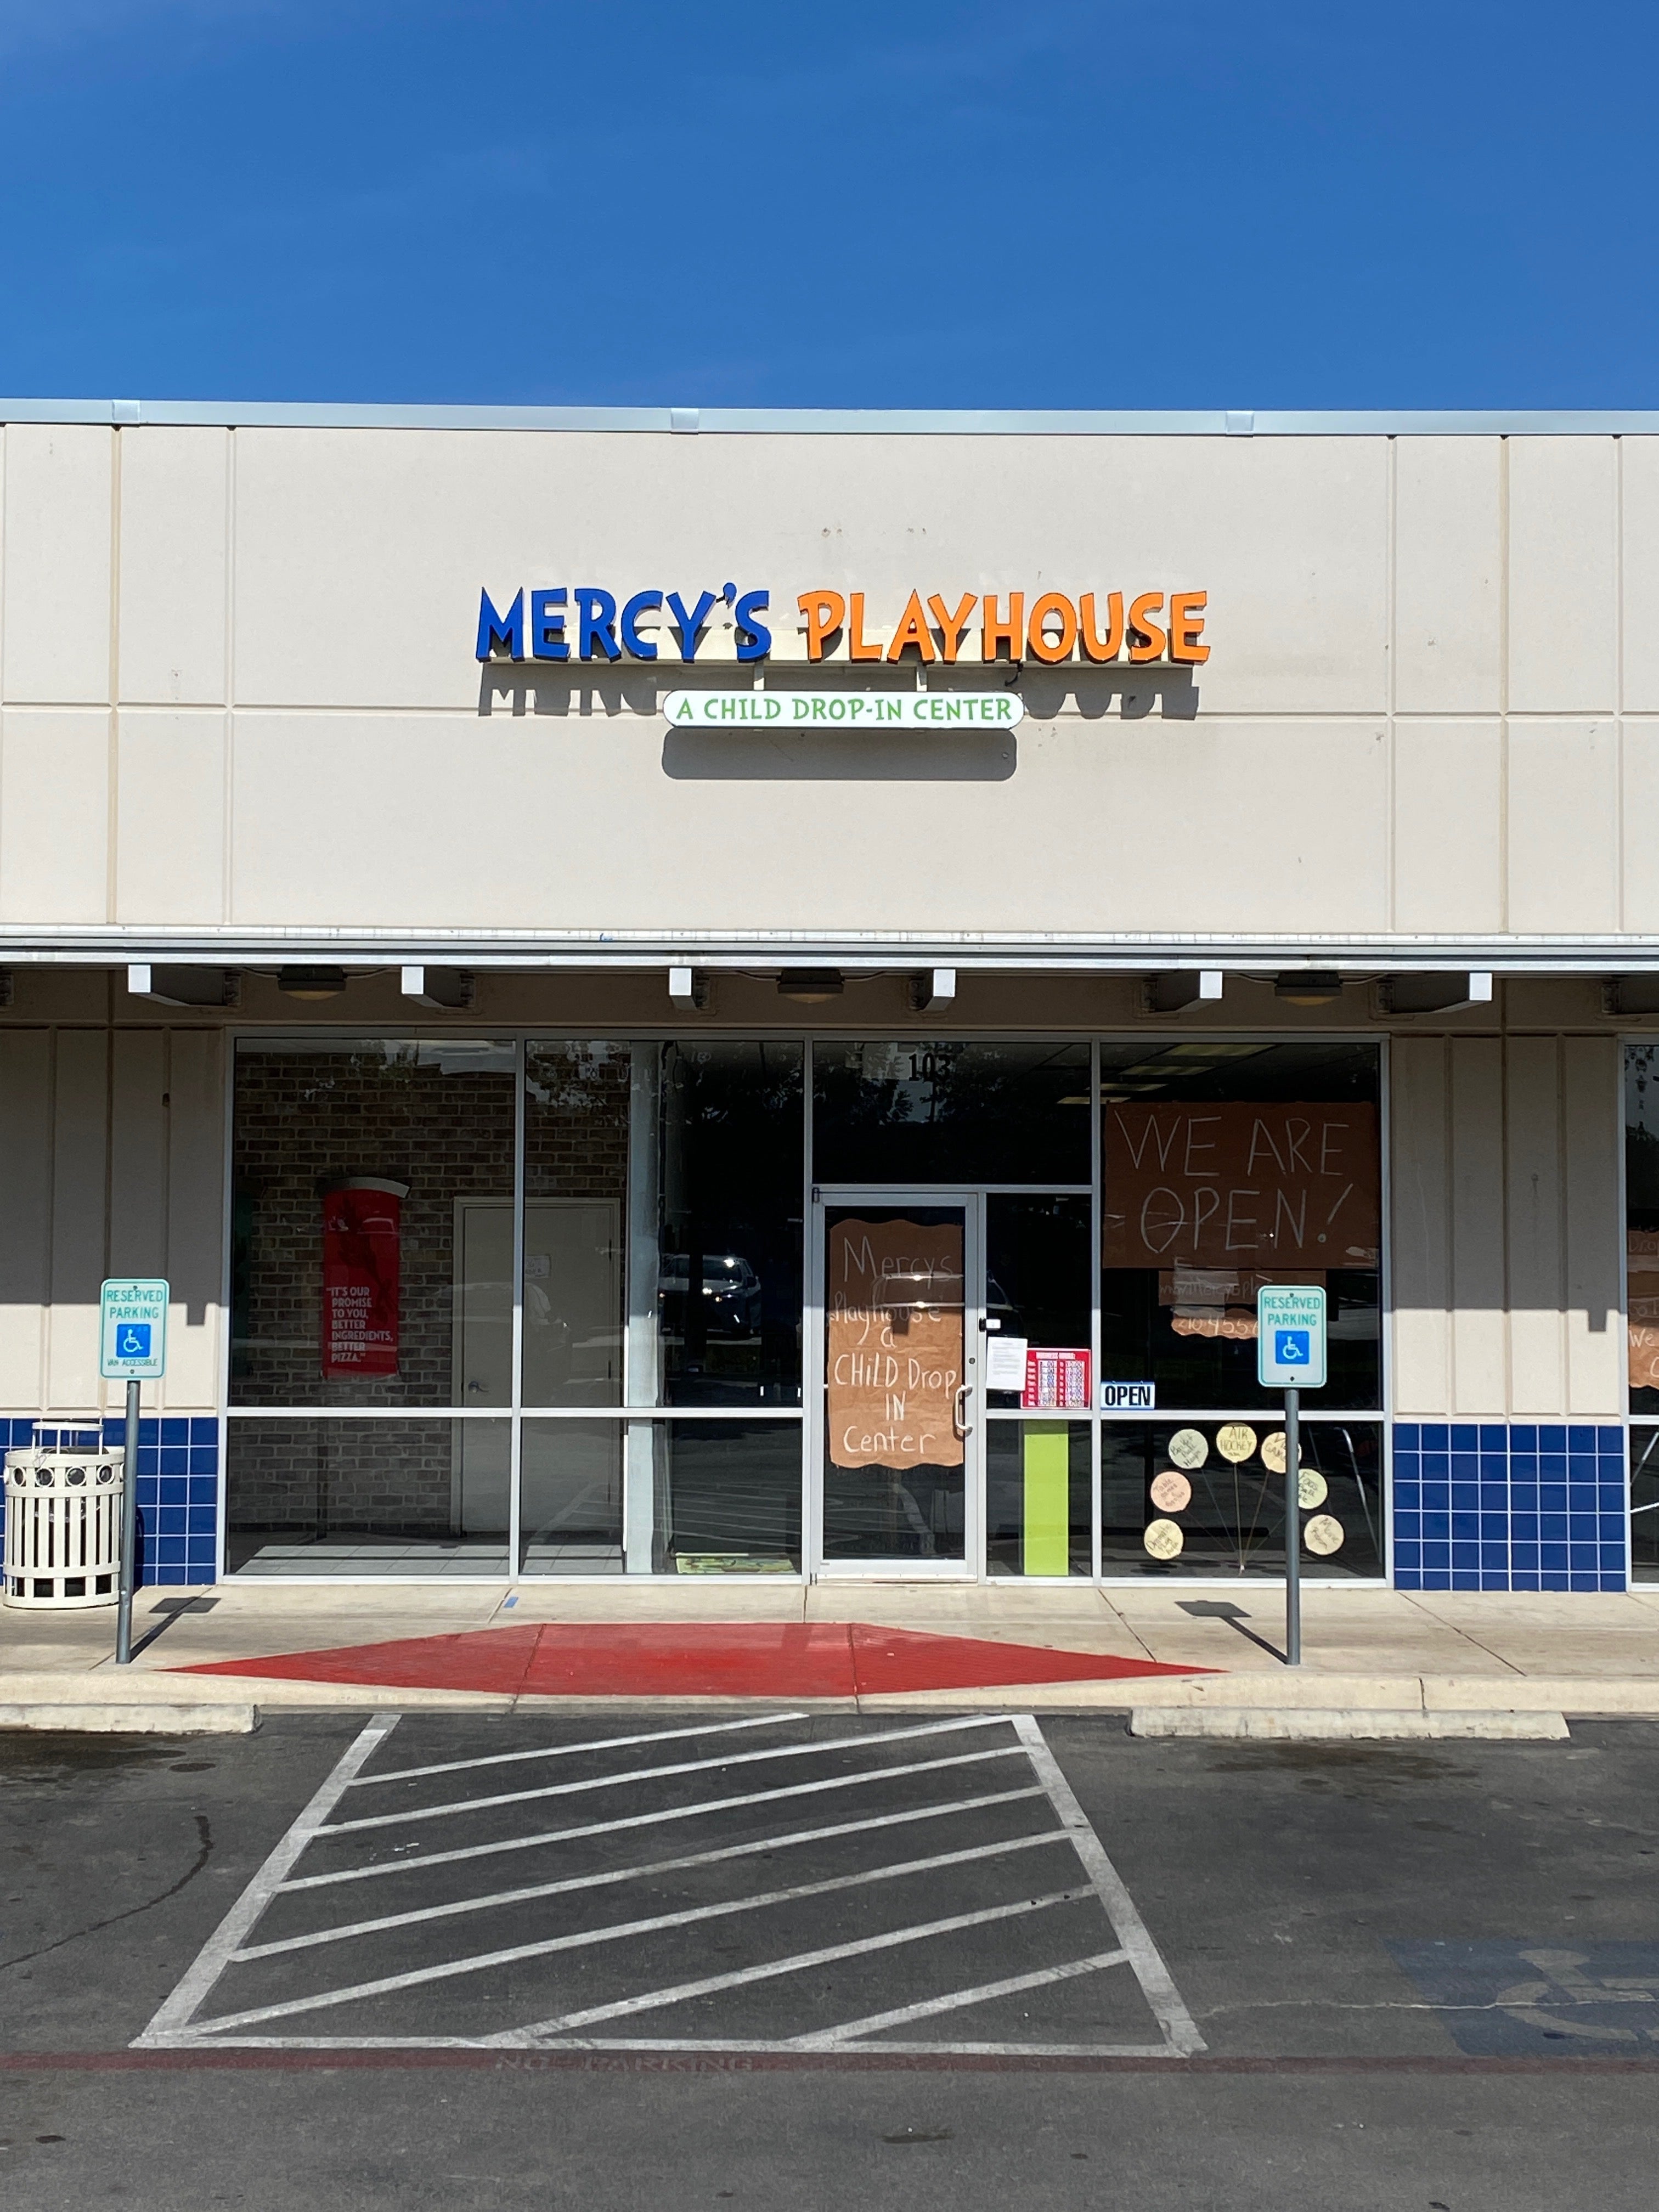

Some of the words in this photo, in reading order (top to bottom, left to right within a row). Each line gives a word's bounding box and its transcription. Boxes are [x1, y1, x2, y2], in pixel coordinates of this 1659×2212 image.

[476, 582, 772, 663] MERCY'S
[797, 589, 1211, 665] PLAYHOUSE
[676, 697, 694, 720] A
[704, 698, 781, 720] CHILD
[792, 698, 902, 721] DROP-IN
[913, 698, 1012, 721] CENTER
[909, 1052, 953, 1082] 103
[1114, 1110, 1222, 1176] WE
[1247, 1118, 1350, 1176] ARE
[1141, 1183, 1353, 1254] OPEN!
[844, 1235, 954, 1290] Mercys
[106, 1290, 163, 1302] RESERVED
[349, 1286, 370, 1296] OUR
[331, 1297, 373, 1308] PROMISE
[1264, 1297, 1321, 1310] RESERVED
[110, 1306, 159, 1319] PARKING
[331, 1308, 345, 1319] TO
[834, 1290, 943, 1345] Playhouse
[1267, 1313, 1317, 1327] PARKING
[331, 1319, 366, 1330] BETTER
[881, 1326, 898, 1348] a
[331, 1342, 366, 1352] BETTER
[122, 1358, 158, 1367] ACCESSIBLE
[908, 1357, 957, 1400] Drop
[1105, 1385, 1150, 1406] OPEN
[885, 1390, 906, 1421] IN
[843, 1426, 937, 1455] Center
[1229, 1427, 1248, 1440] AIR
[583, 2056, 752, 2072] PARKING
